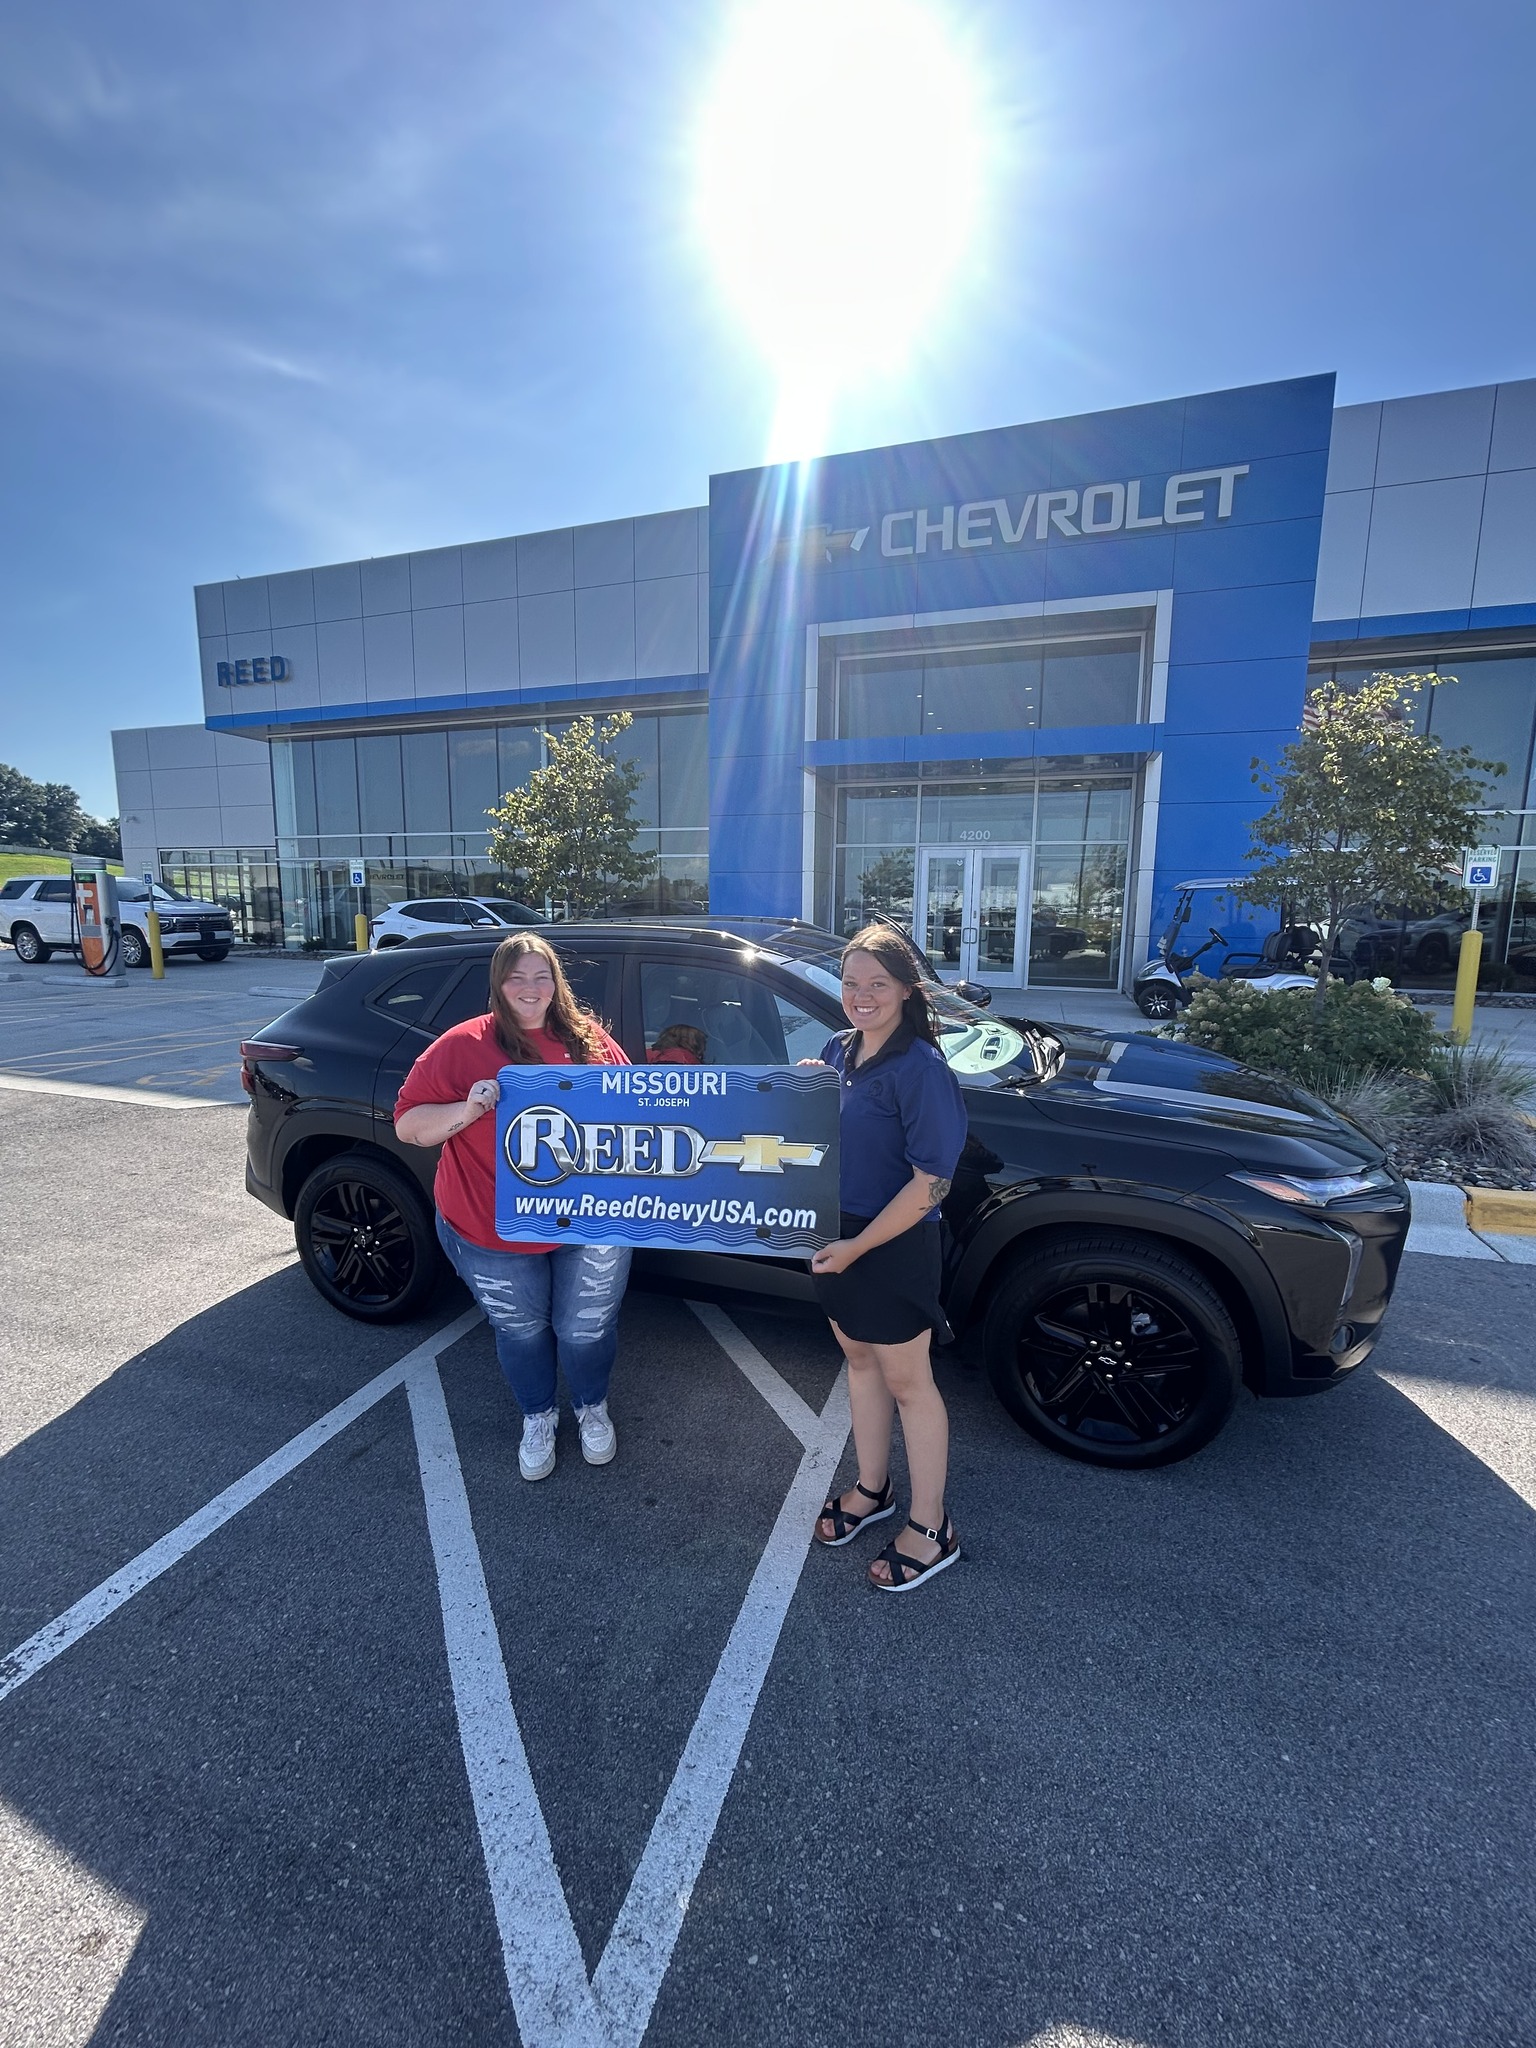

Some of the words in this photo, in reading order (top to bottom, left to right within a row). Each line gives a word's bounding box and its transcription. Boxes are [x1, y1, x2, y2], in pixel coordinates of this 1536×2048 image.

[881, 465, 1250, 558] CHEVROLET
[217, 656, 288, 687] REED
[960, 830, 991, 841] 4200
[602, 1071, 728, 1096] MISSOURI
[637, 1097, 652, 1107] ST.
[654, 1097, 690, 1107] JOSEPH
[513, 1112, 707, 1178] REED
[515, 1194, 817, 1229] www.ReedChevyUSA.com
